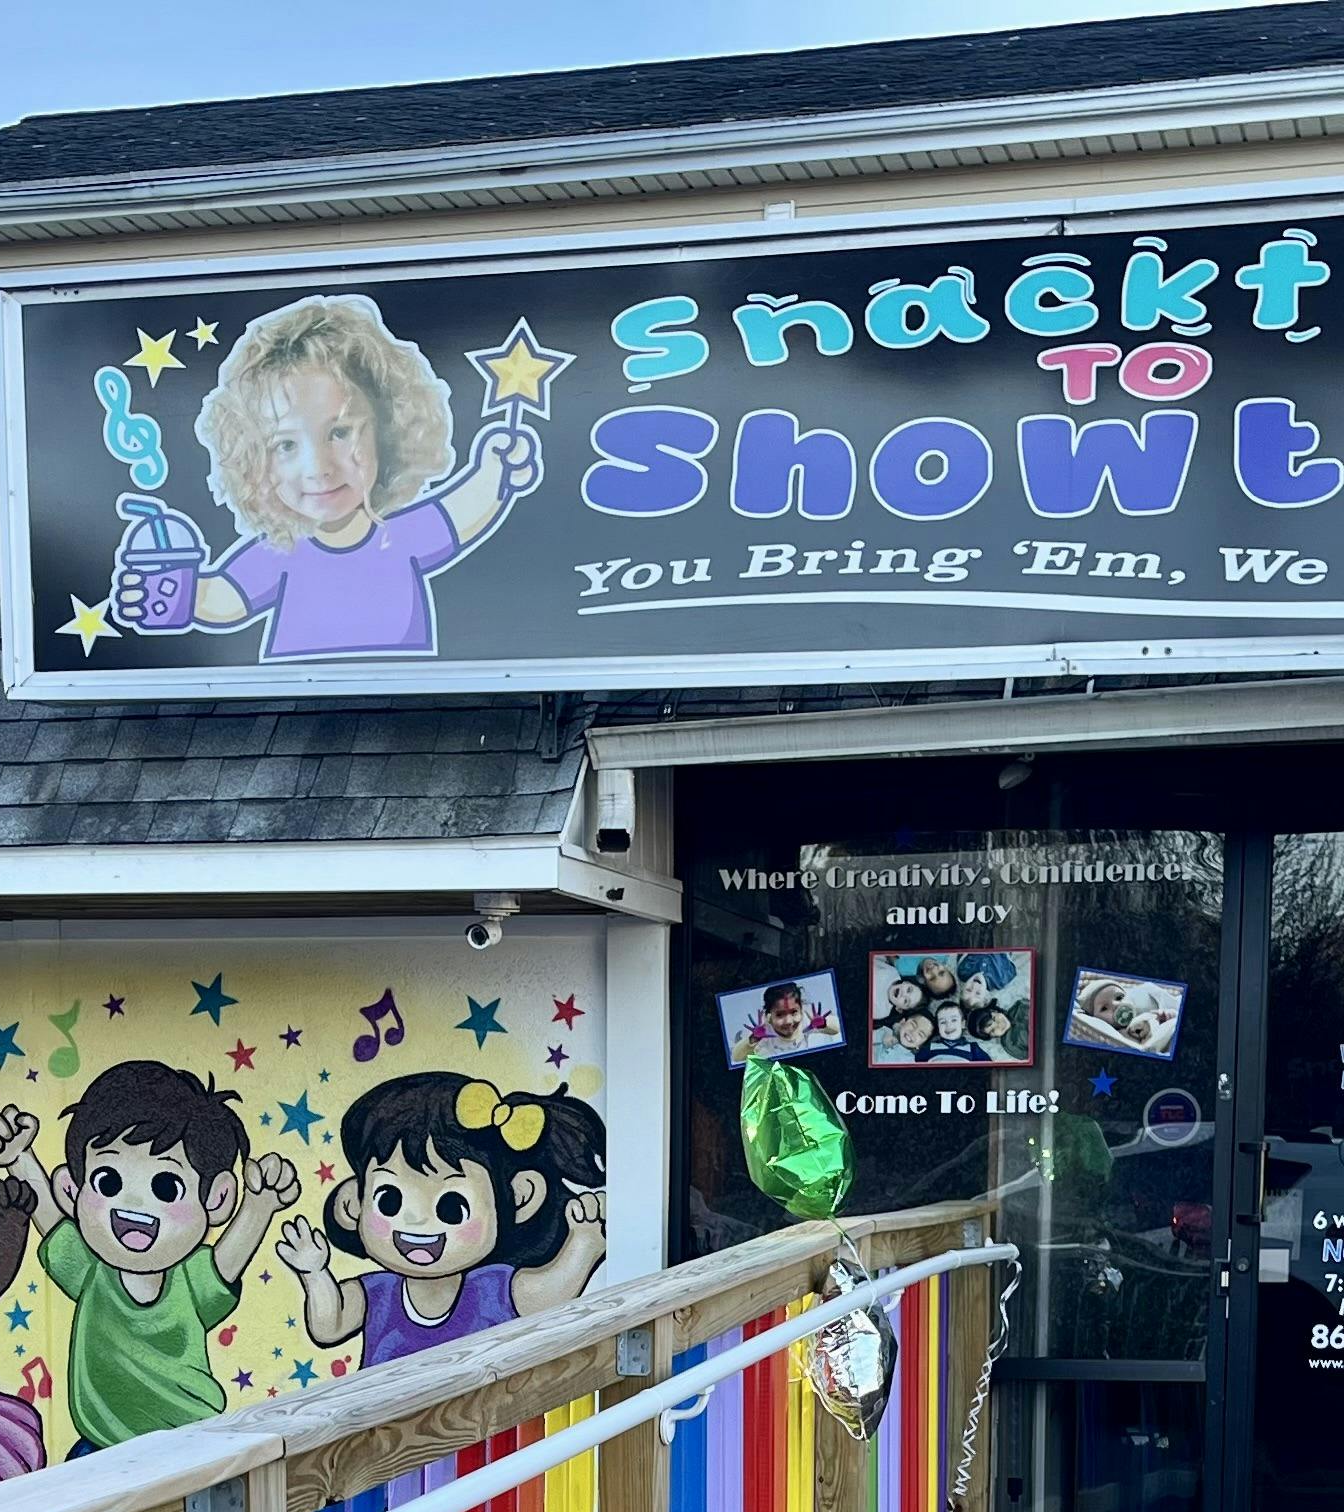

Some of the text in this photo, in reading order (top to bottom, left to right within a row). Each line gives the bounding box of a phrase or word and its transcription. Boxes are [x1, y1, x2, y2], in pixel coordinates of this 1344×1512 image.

[1037, 341, 1213, 405] TO
[574, 556, 712, 597] You
[739, 540, 983, 582] Bring
[1218, 546, 1328, 585] We
[718, 868, 820, 890] Where
[886, 901, 1013, 925] and Joy
[836, 1089, 1060, 1114] Come To Life!
[1312, 1211, 1327, 1230] 6
